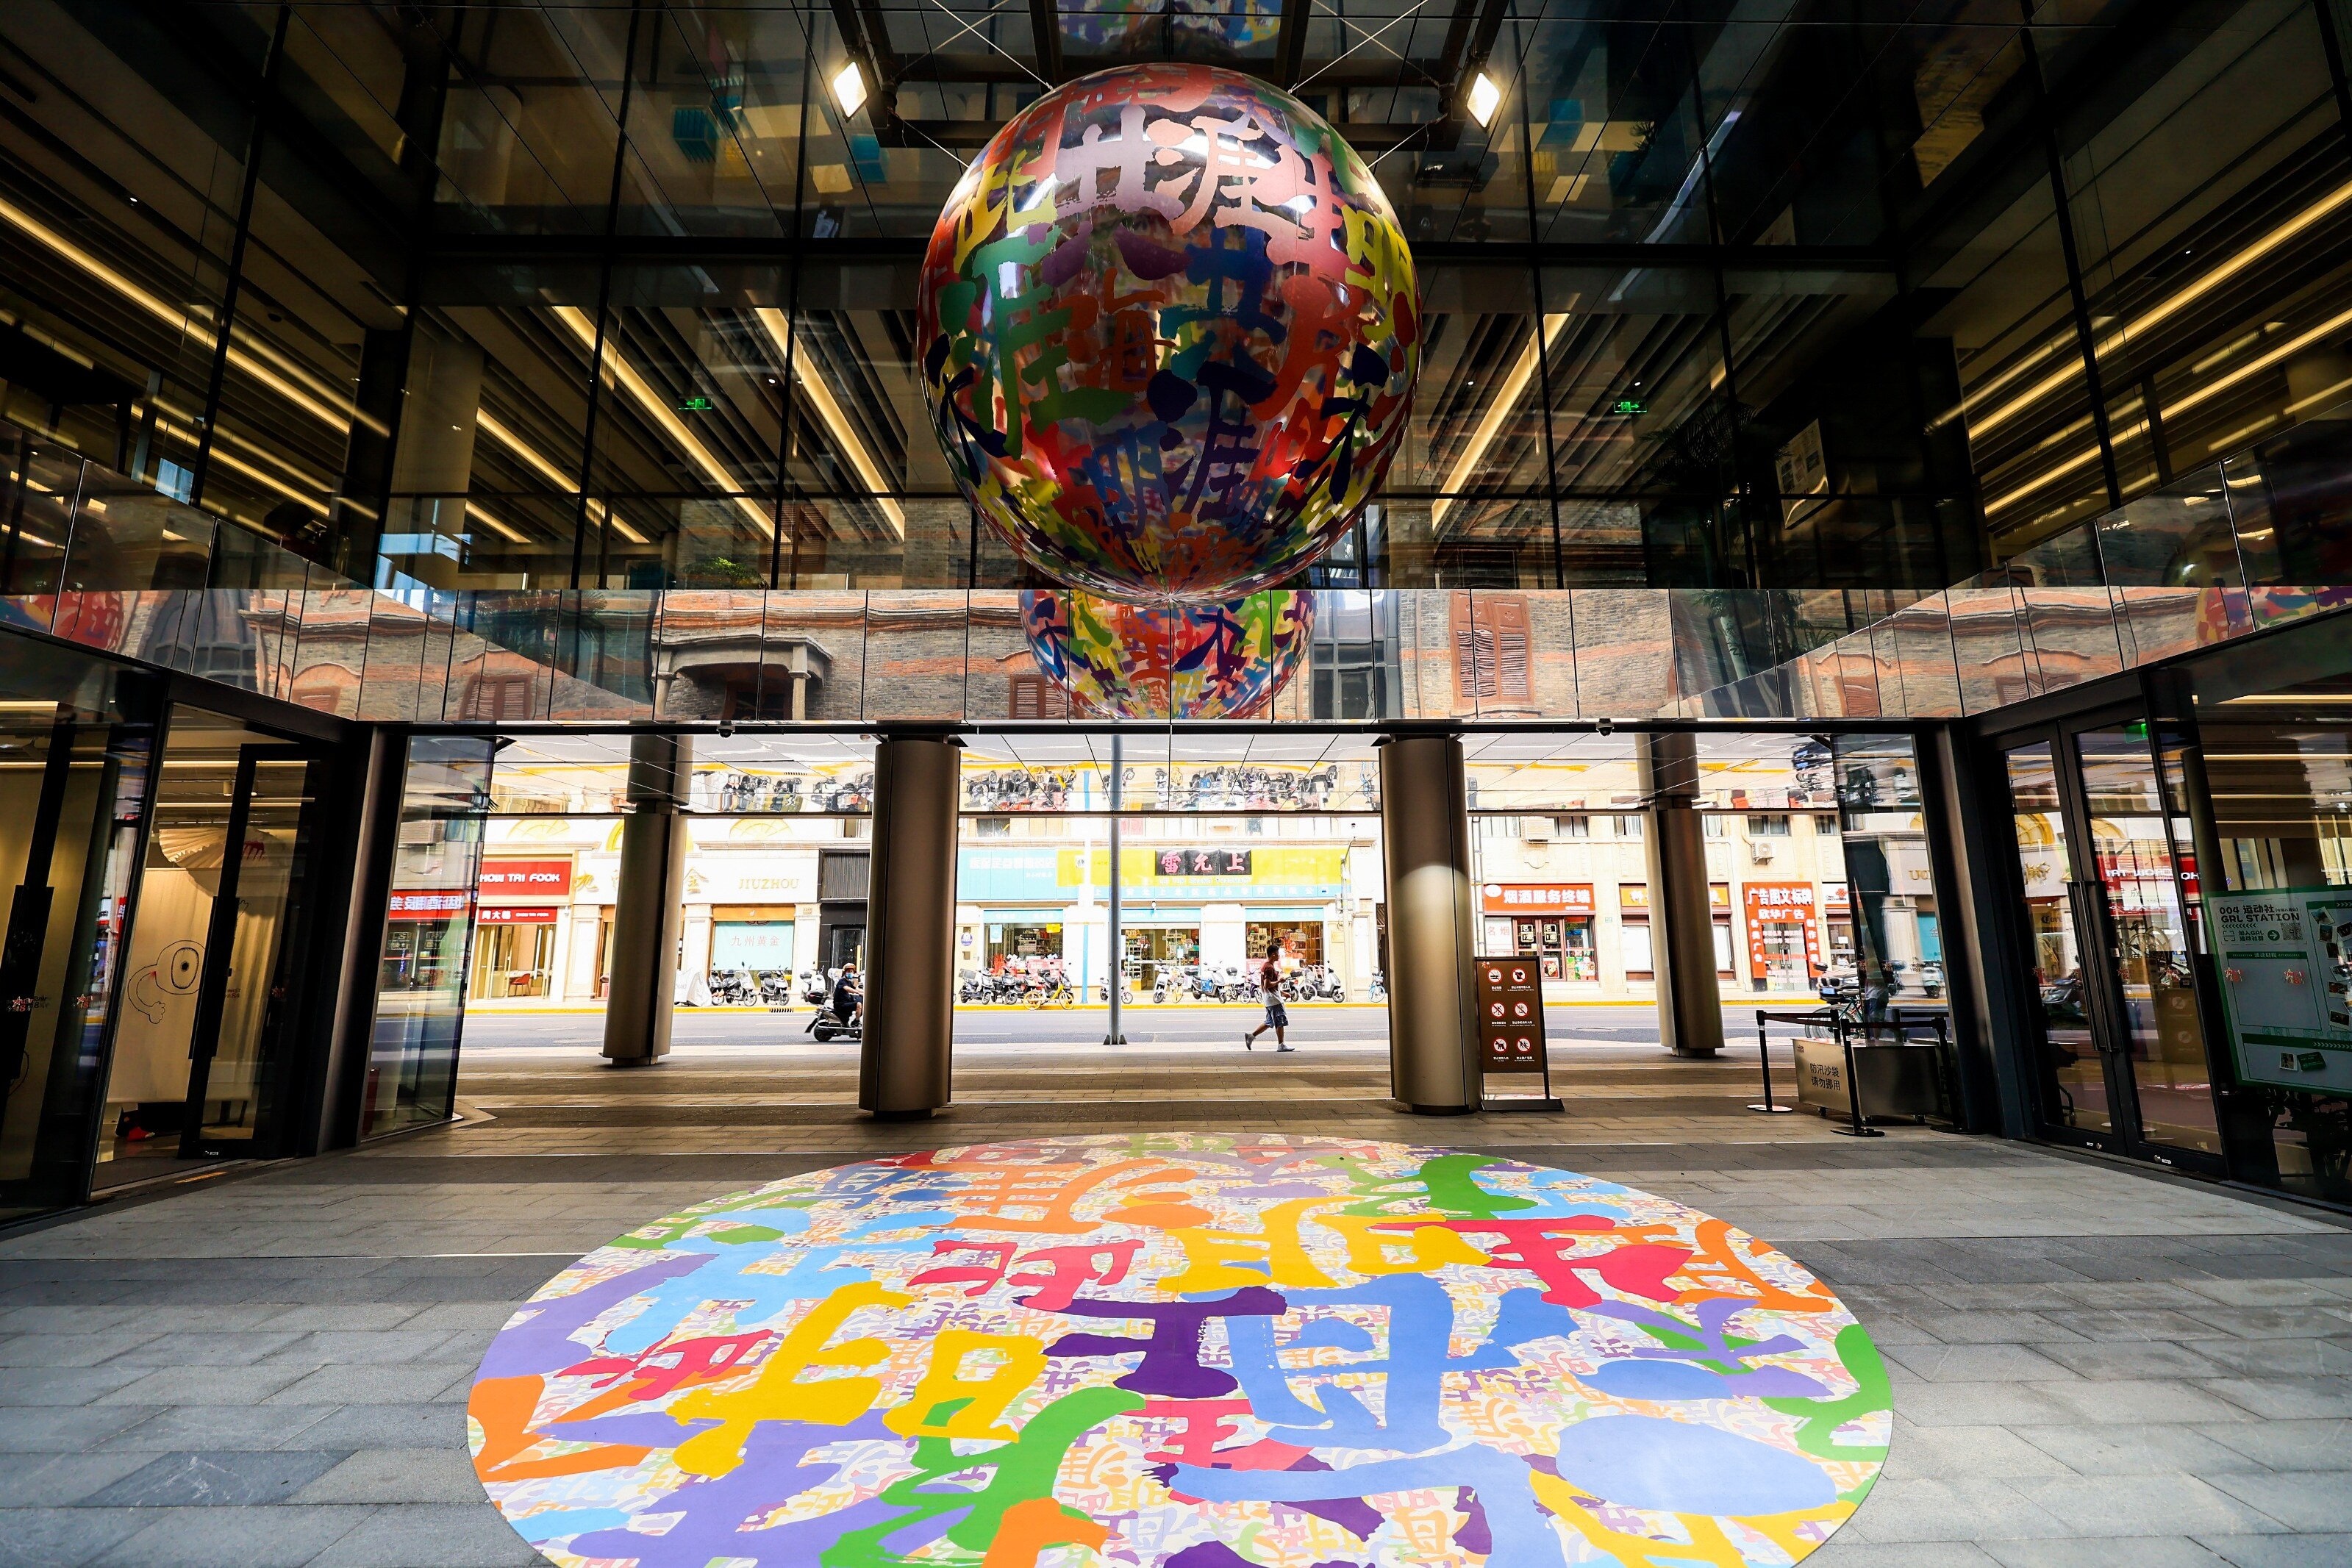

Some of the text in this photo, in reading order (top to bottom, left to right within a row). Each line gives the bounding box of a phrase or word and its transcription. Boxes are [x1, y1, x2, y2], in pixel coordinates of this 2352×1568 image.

[1161, 851, 1245, 873] 雷允上
[479, 873, 560, 883] HOW TAI FOOK
[738, 878, 799, 889] JIUZHOU
[1504, 889, 1590, 903] 烟酒服务终端
[1748, 888, 1814, 906] 广告图文标牌
[2242, 903, 2276, 914] 运动社
[482, 910, 512, 920] 周大福
[1759, 909, 1805, 920] 欣华广告
[2221, 913, 2300, 923] GRL STATION
[731, 935, 781, 946] 九州黄金
[1809, 1063, 1840, 1077] 防汛沙袋
[1812, 1076, 1840, 1091] 请勿挪用
[1012, 1285, 1287, 1399] 上
